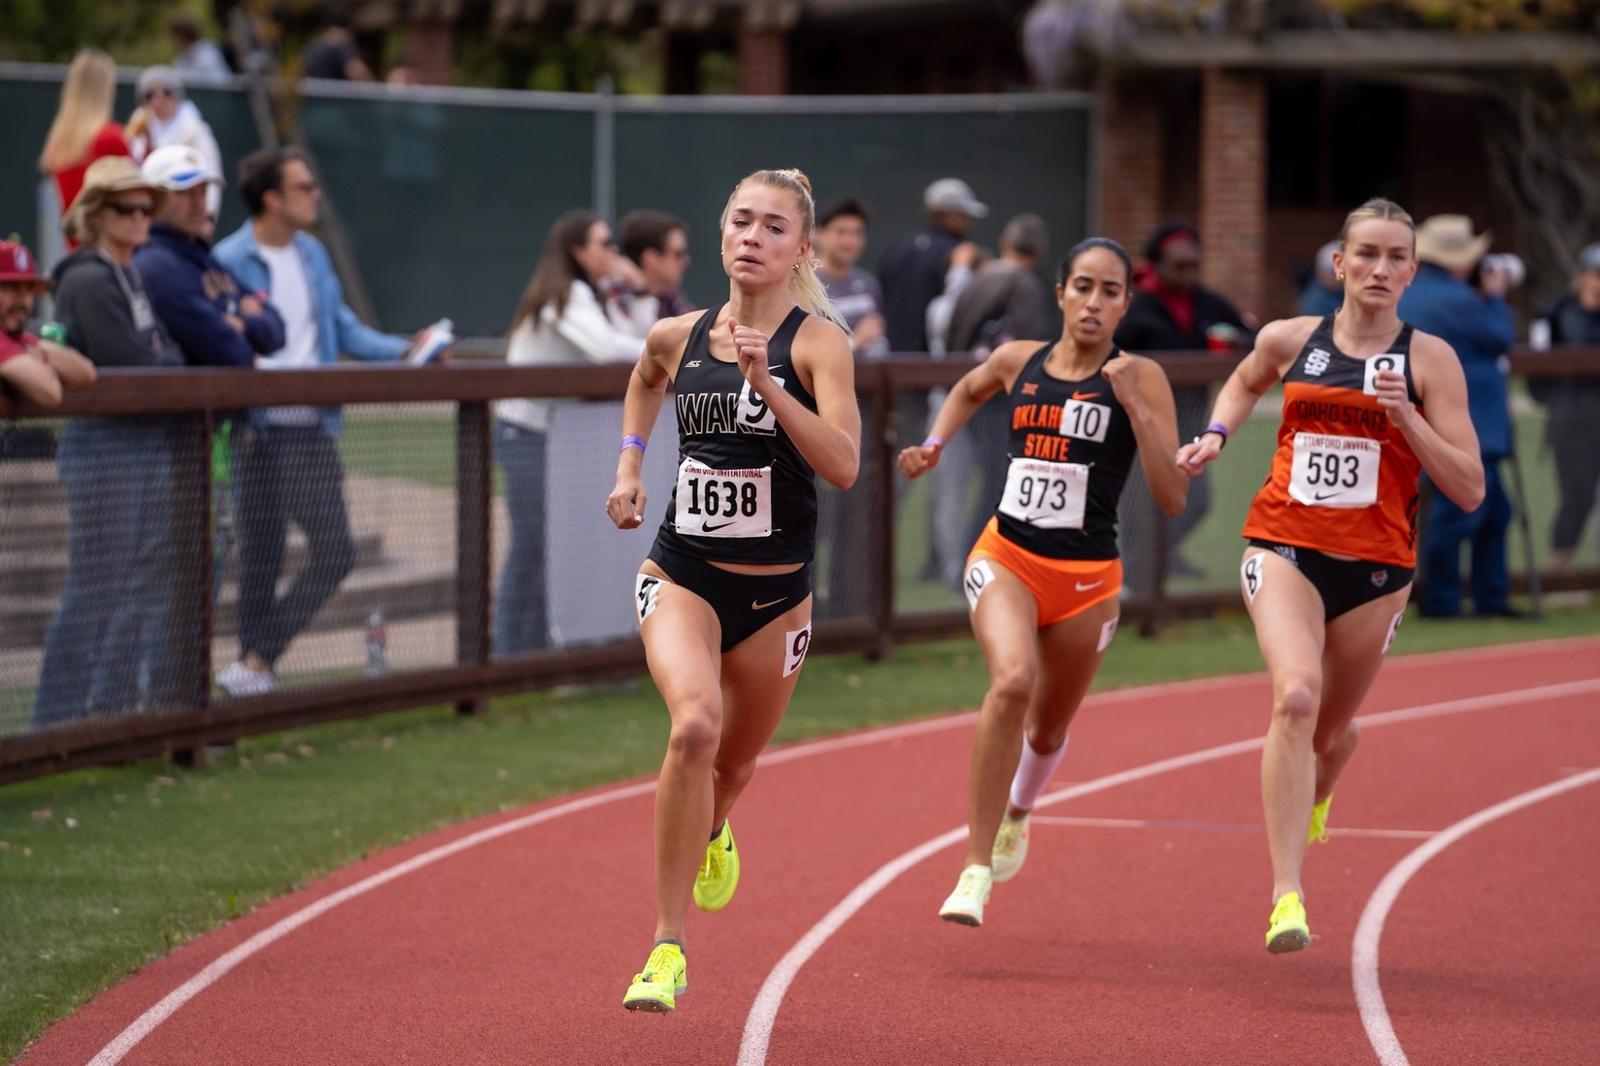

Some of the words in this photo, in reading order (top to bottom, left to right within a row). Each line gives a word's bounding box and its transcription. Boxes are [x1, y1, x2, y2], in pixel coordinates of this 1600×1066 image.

[684, 360, 702, 368] ACC
[677, 392, 777, 437] WAK
[1072, 404, 1101, 438] 10
[1024, 433, 1071, 461] STATE
[1306, 451, 1359, 488] 593
[687, 477, 757, 517] 1638
[1019, 476, 1067, 511] 973
[790, 629, 809, 671] 9
